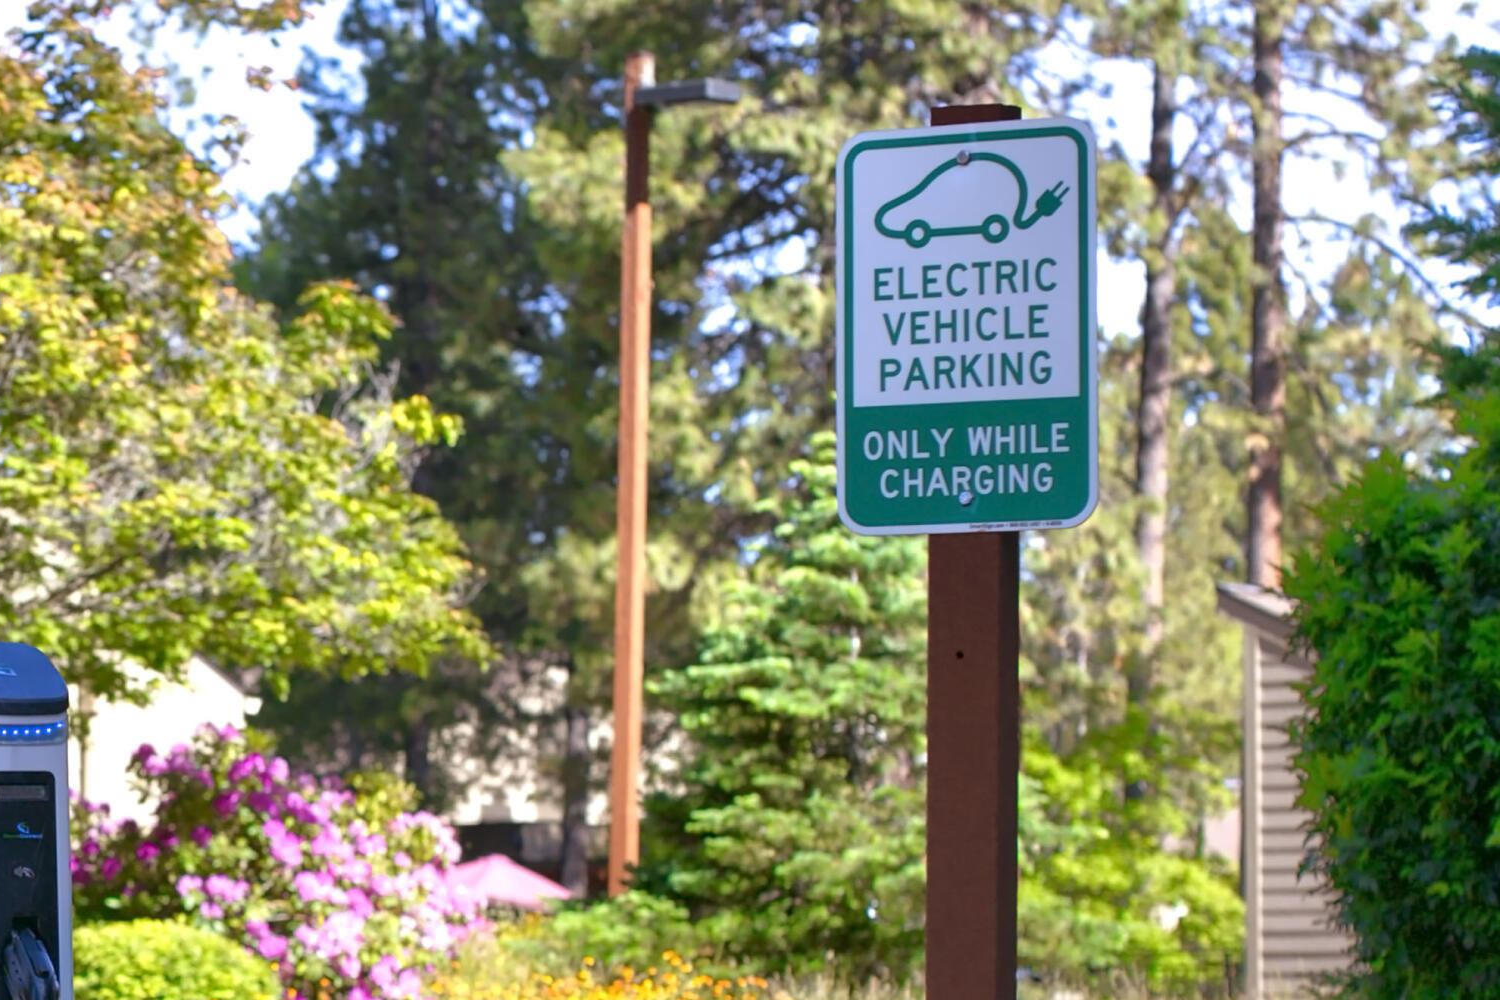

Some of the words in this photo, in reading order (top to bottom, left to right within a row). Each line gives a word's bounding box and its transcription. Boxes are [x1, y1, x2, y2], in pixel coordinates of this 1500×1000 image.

[873, 257, 1058, 302] ELECTRIC
[882, 304, 1050, 346] VEHICLE
[879, 349, 1053, 393] PARKING
[862, 427, 955, 462] ONLY
[967, 422, 1071, 456] WHILE
[879, 462, 1054, 499] CHARGING
